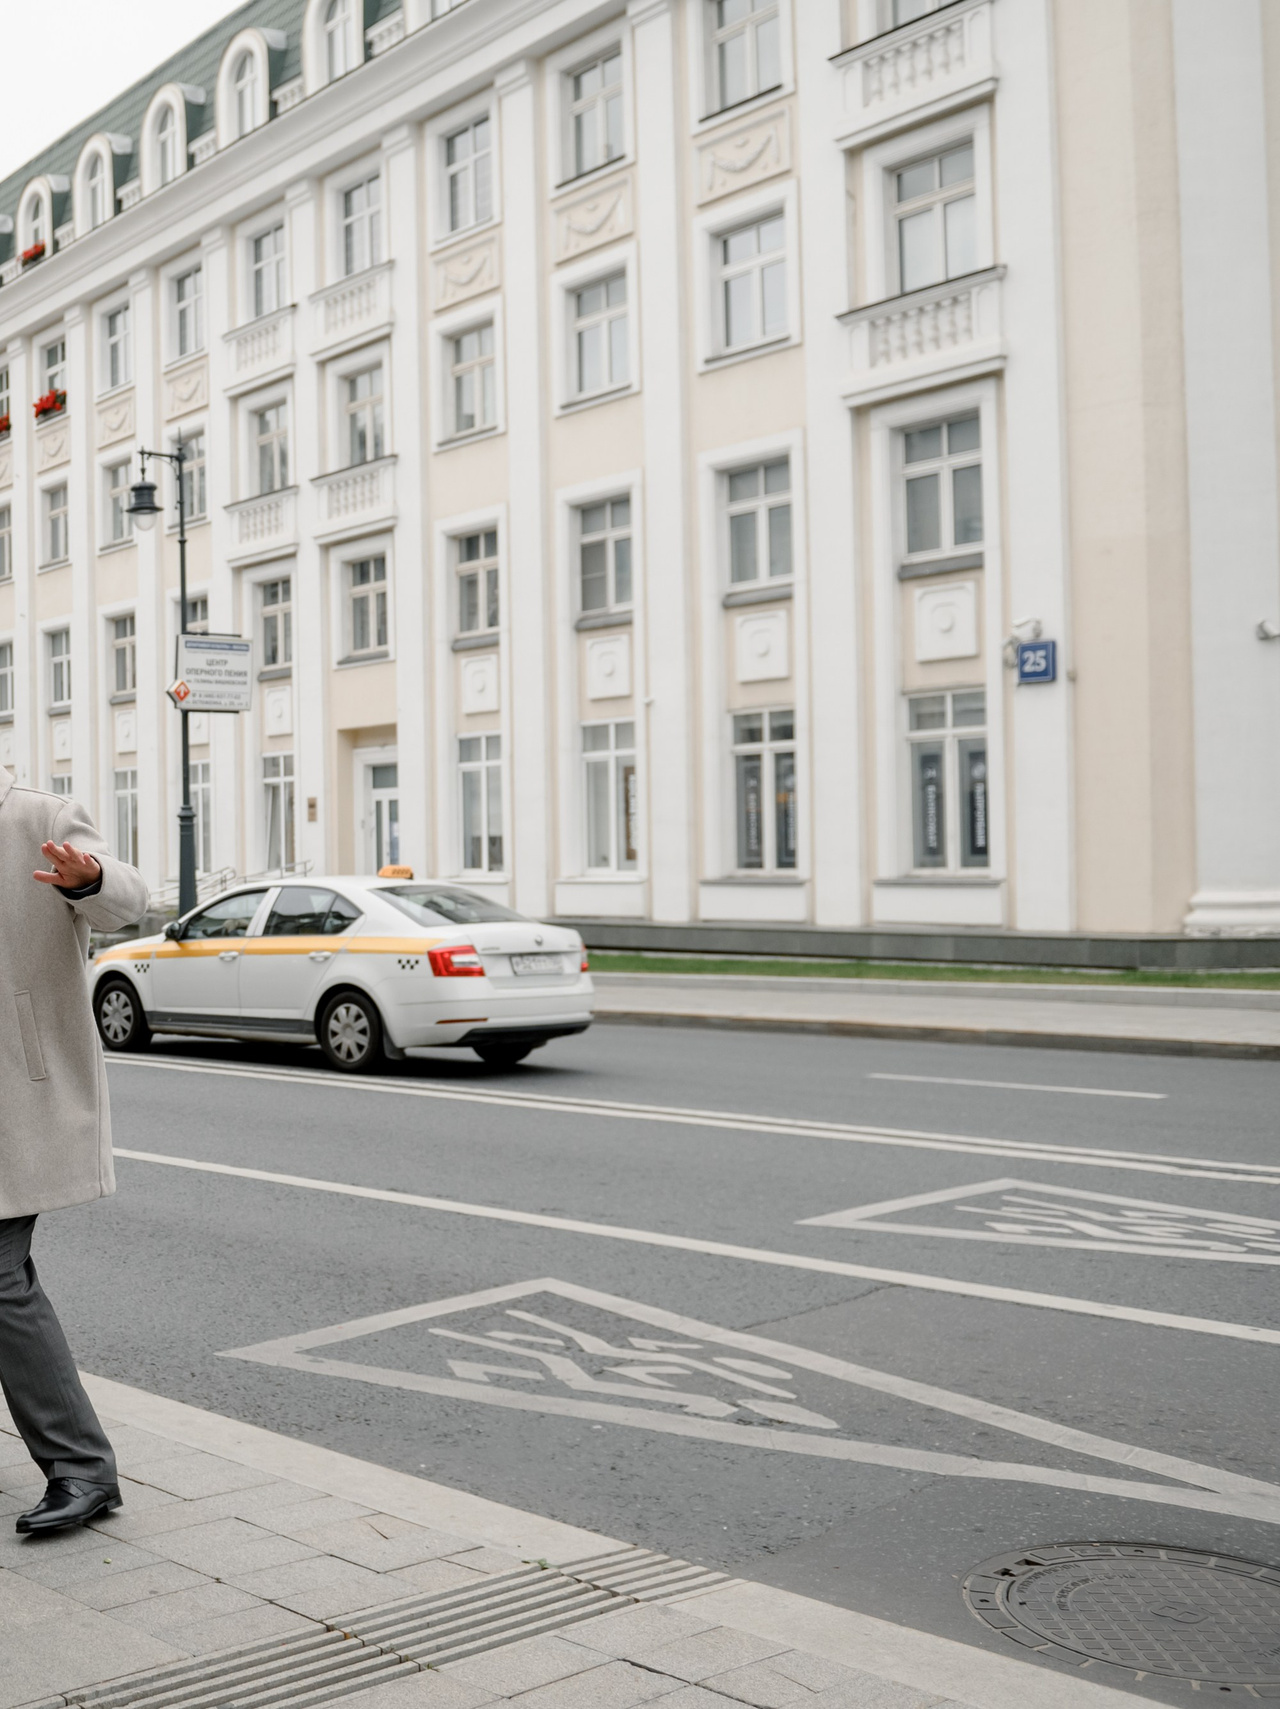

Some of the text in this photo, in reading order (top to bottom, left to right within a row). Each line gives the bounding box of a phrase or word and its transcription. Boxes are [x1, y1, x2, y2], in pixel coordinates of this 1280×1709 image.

[206, 659, 228, 667] ЦЕНТР
[1022, 650, 1047, 673] 25
[186, 668, 248, 678] ОПЕРНОГО ПЕНИЯ
